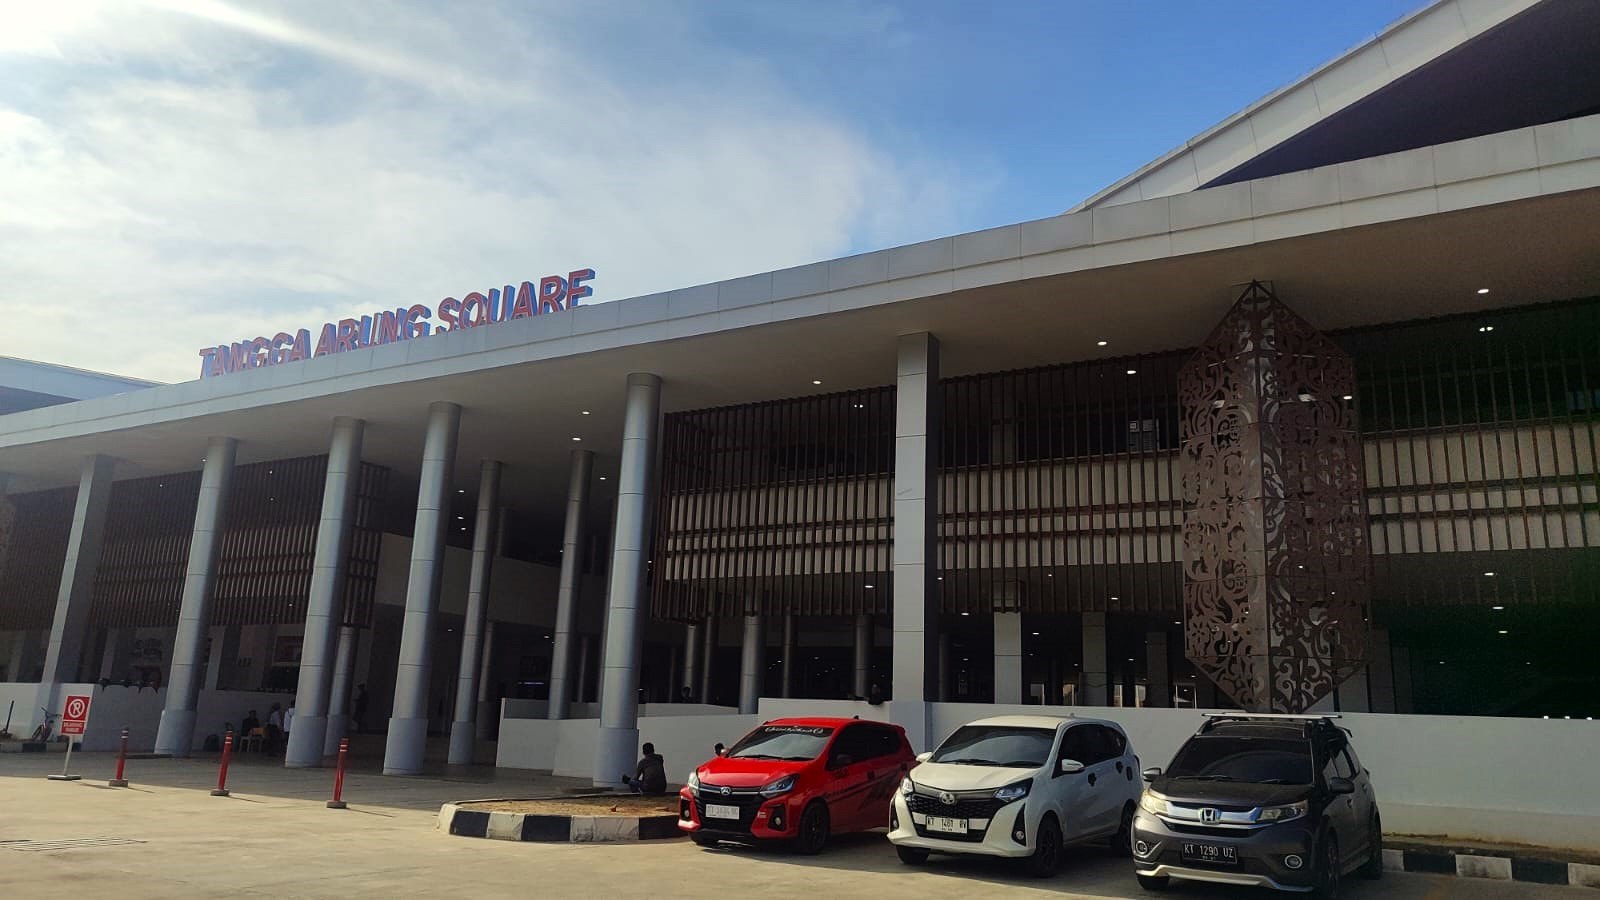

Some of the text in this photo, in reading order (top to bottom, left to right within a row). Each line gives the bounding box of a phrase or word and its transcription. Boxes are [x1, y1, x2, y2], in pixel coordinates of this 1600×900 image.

[199, 268, 596, 379] TANGGA ARUNG SQUARE
[1184, 843, 1194, 854] KT
[1200, 845, 1219, 857] 1290
[1223, 847, 1234, 858] UZ
